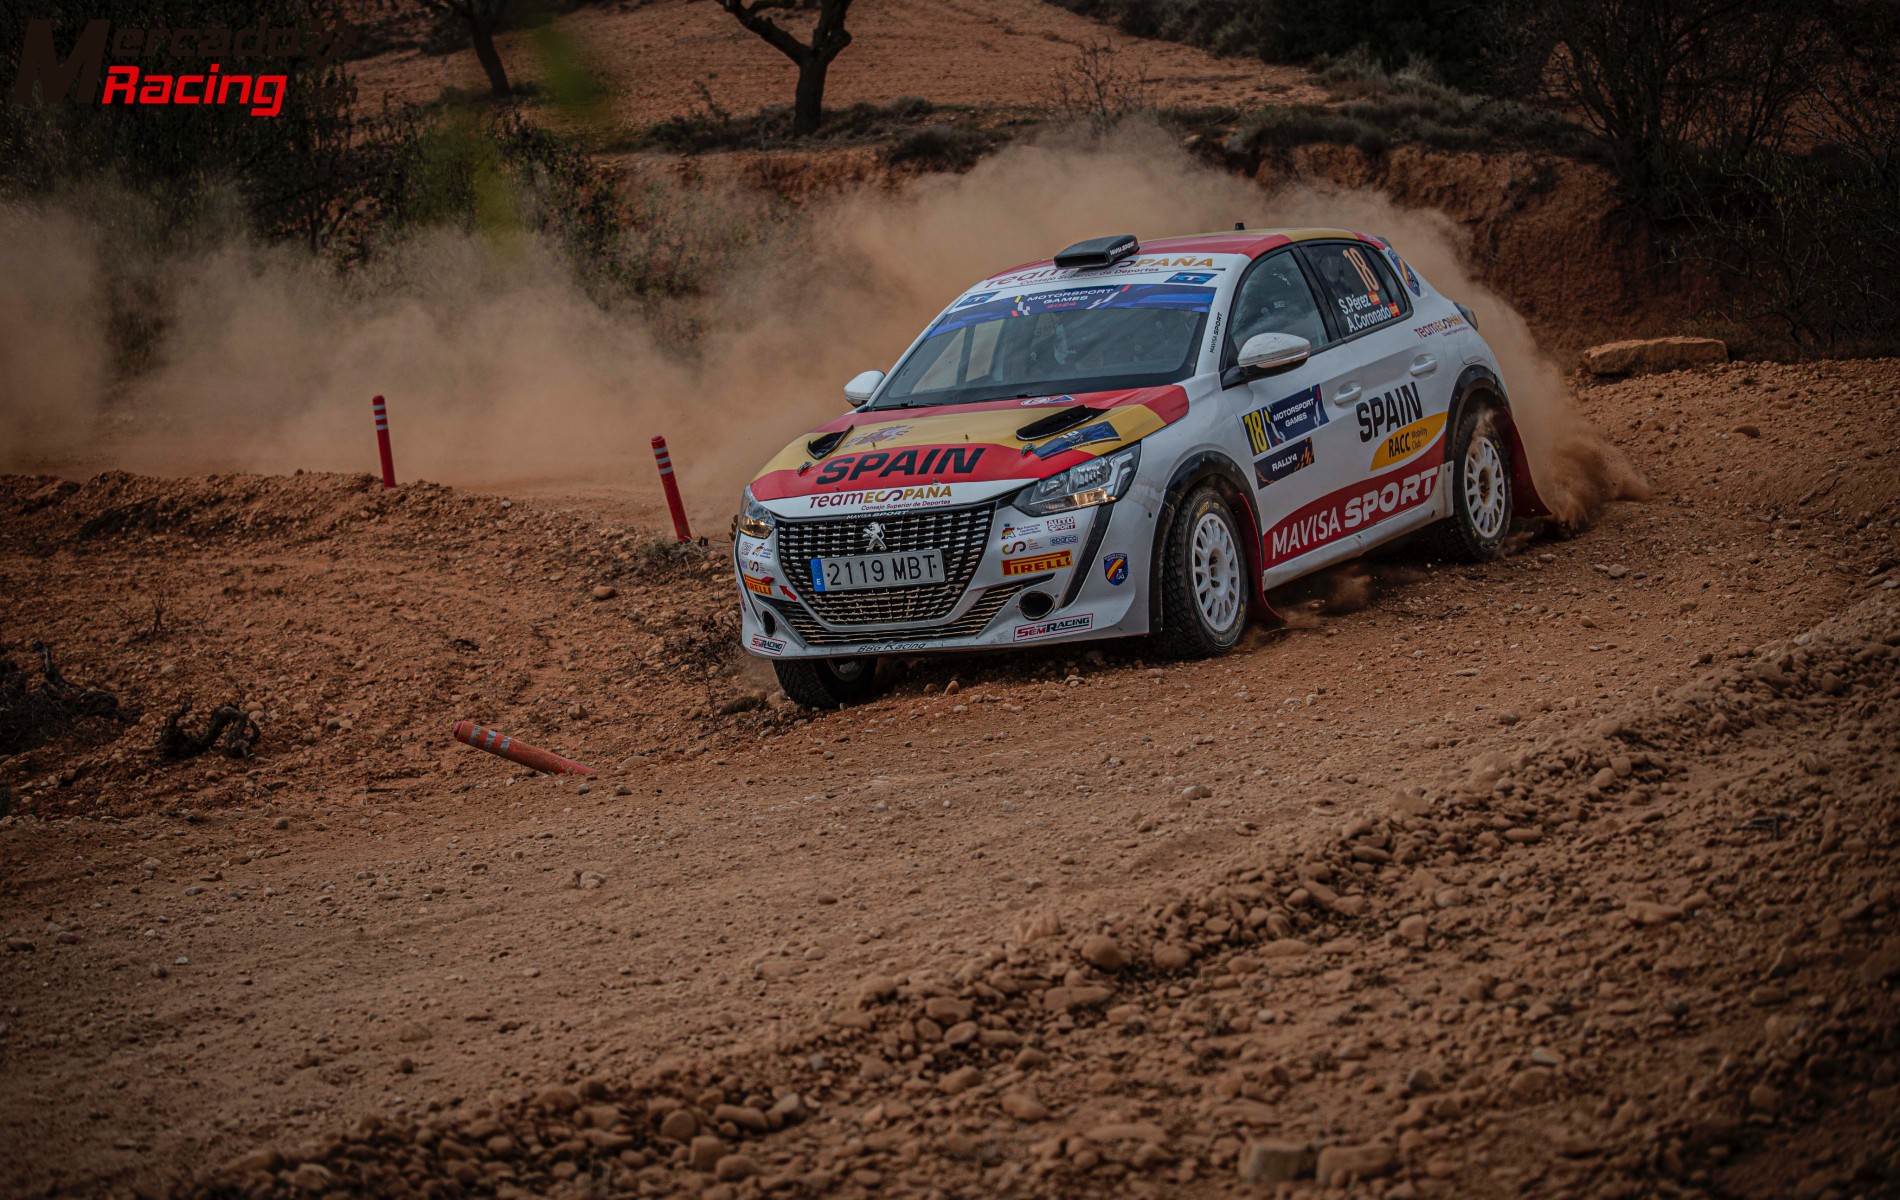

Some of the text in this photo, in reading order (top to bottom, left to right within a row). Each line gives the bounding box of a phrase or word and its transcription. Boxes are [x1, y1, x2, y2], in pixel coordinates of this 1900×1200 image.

[1114, 267, 1159, 275] Deportes
[1343, 247, 1379, 291] 18
[1026, 288, 1114, 302] MOTORSPORT
[1043, 295, 1089, 304] GAMES
[1338, 294, 1372, 315] S.Pérez
[1213, 312, 1223, 336] SPORT
[1346, 304, 1392, 332] A.Coronado
[1273, 398, 1315, 422] MOTORSPORT
[1285, 412, 1308, 428] GAMES
[1355, 381, 1423, 443] SPAIN
[1244, 411, 1268, 455] 18
[1388, 432, 1411, 458] RACC
[816, 448, 986, 485] SPAIN
[1271, 453, 1298, 472] RALLY4
[886, 502, 912, 510] Superior
[922, 499, 951, 507] Deportes
[1271, 466, 1438, 560] MAVISA SPORT
[1048, 517, 1073, 527] AUTO
[828, 555, 935, 586] 2119 MBT
[1002, 550, 1071, 576] PIRELLI
[884, 641, 926, 651] Racing
